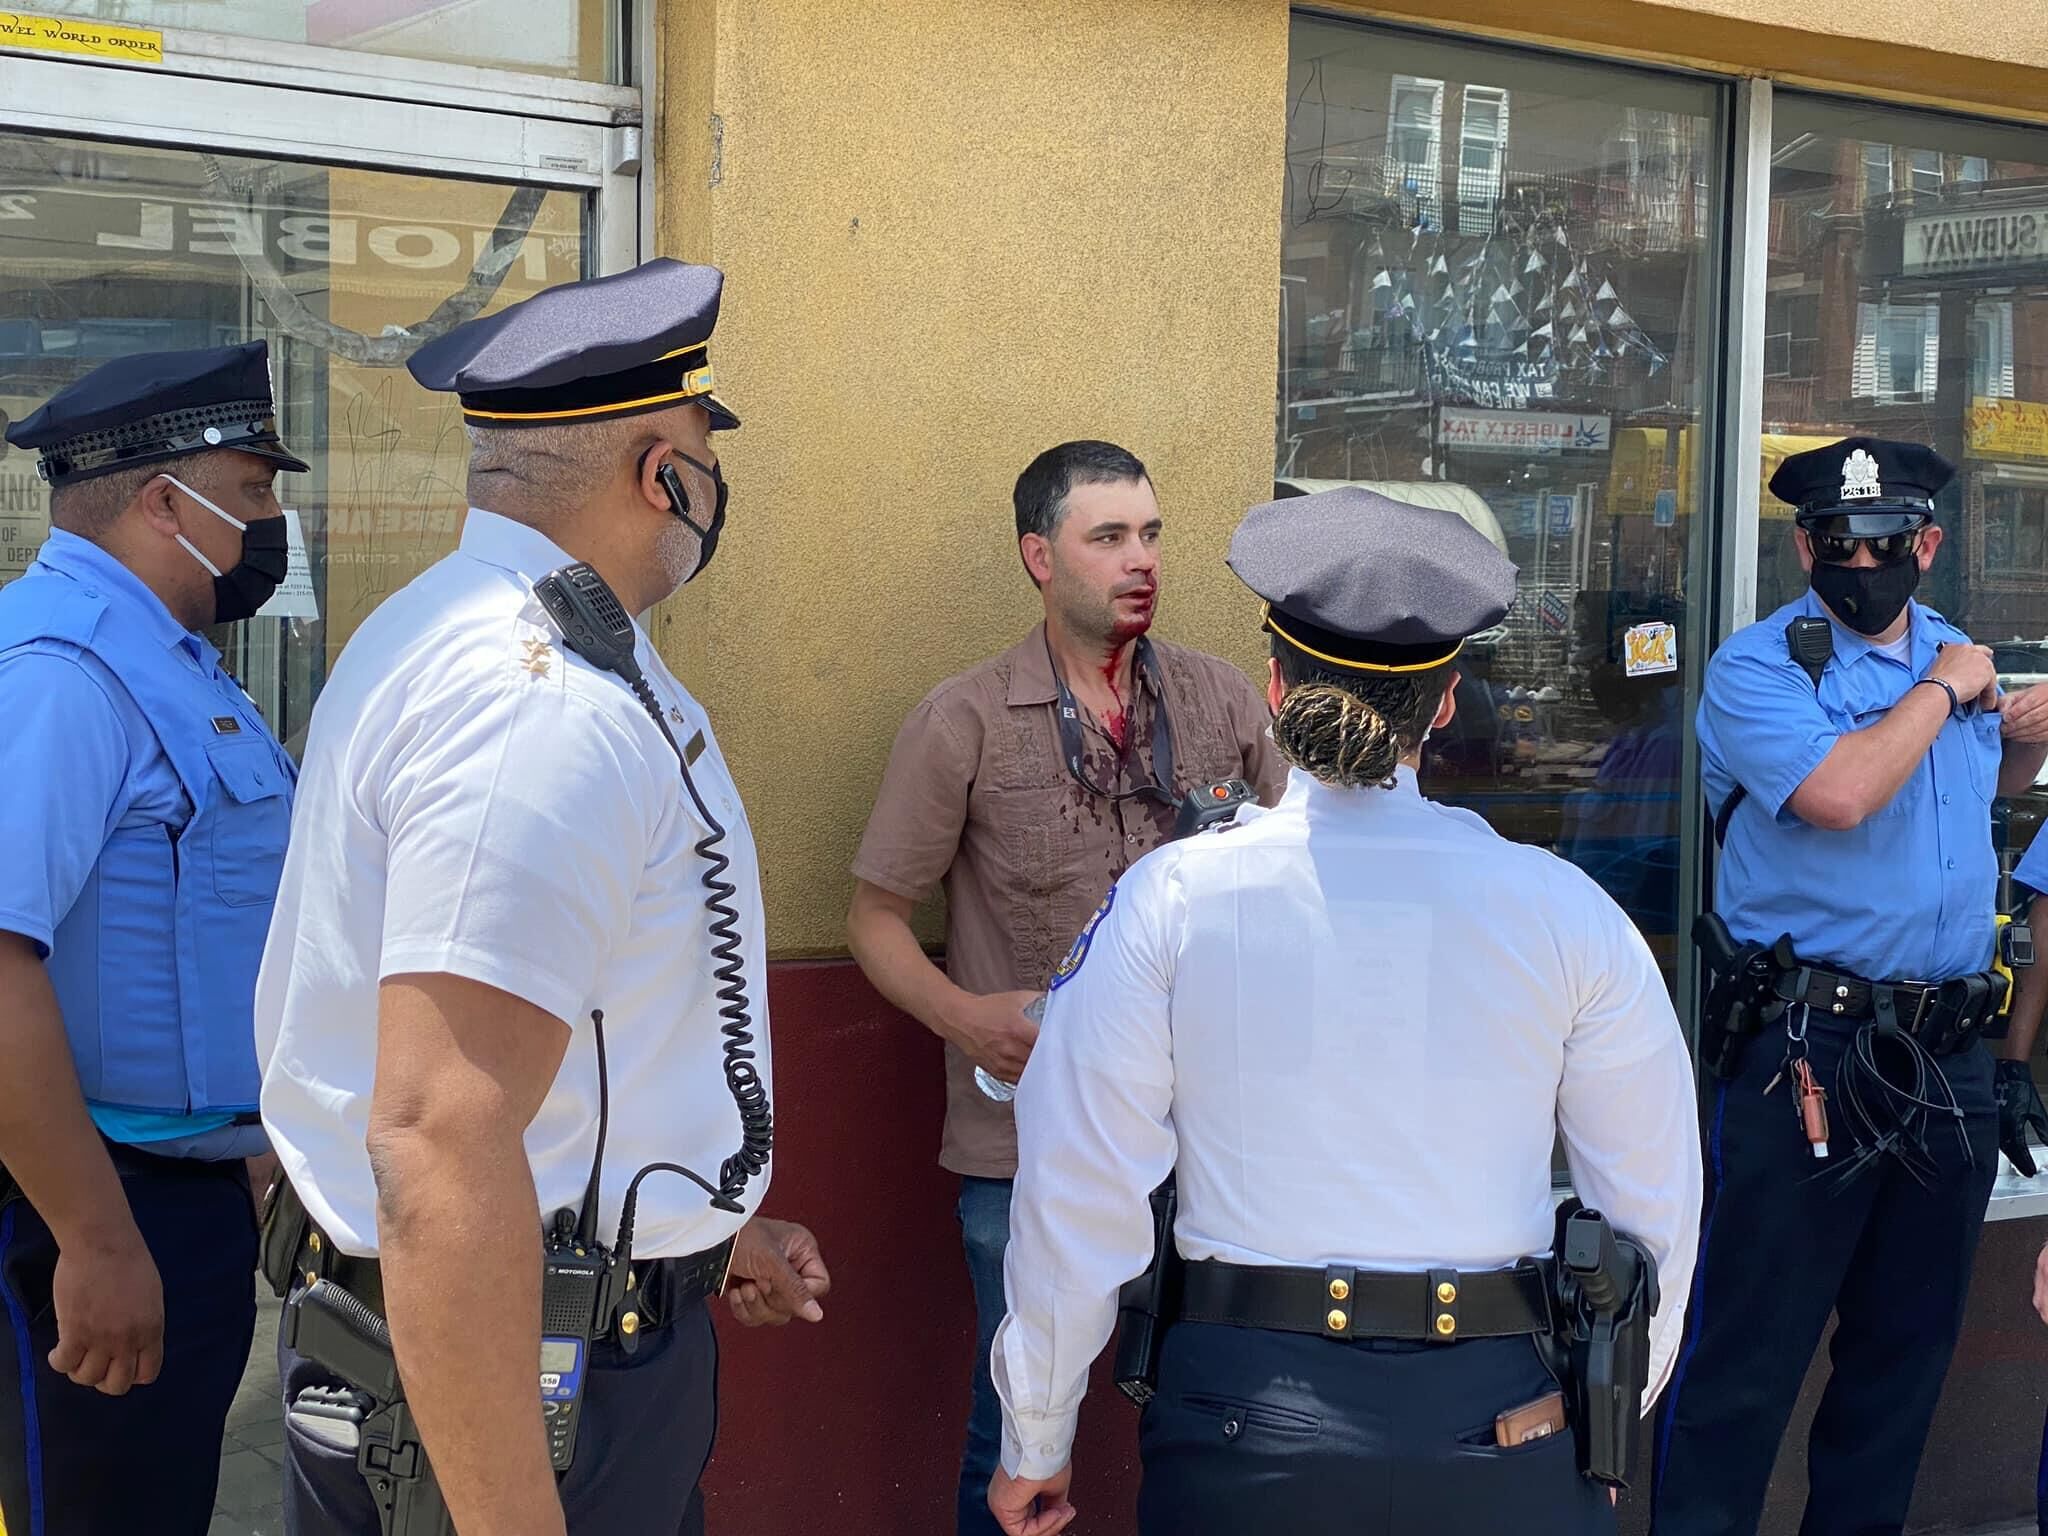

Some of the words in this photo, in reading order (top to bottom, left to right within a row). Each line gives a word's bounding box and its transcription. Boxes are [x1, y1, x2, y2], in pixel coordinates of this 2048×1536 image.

[43, 19, 108, 52] WORLD
[108, 37, 162, 58] ORDER
[2, 526, 17, 543] OF
[558, 1268, 594, 1276] MOTOROLA
